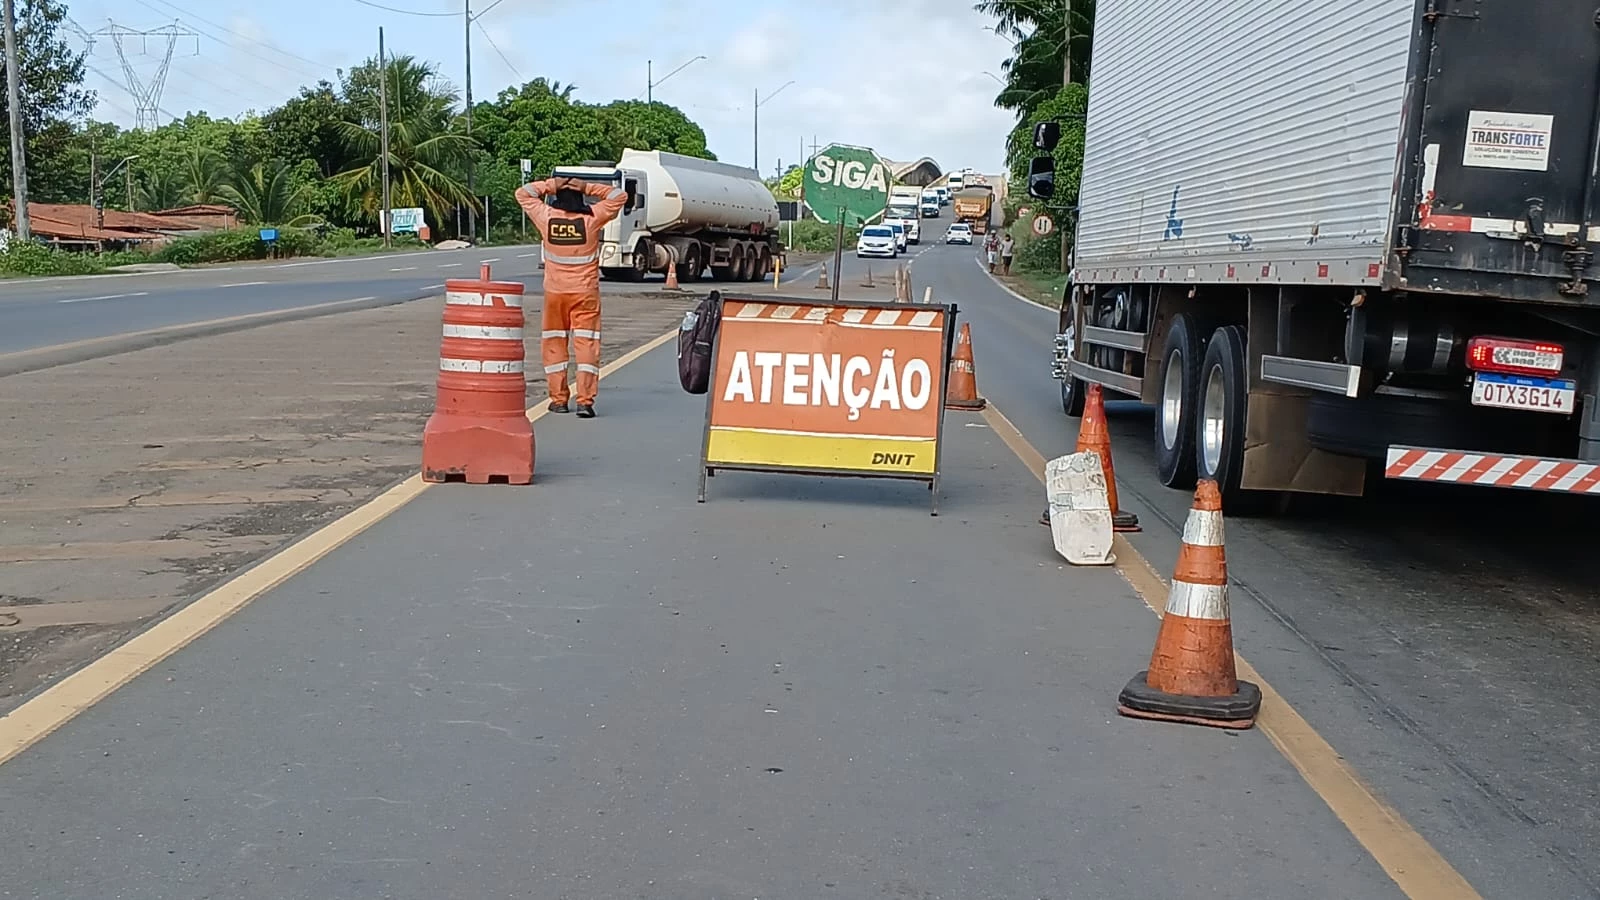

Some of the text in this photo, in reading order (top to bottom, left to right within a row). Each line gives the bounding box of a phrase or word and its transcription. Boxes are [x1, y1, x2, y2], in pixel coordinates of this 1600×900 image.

[1472, 131, 1545, 147] TRANSFORTE
[811, 155, 887, 193] SIGA
[723, 348, 932, 421] ATENÇÃO
[1484, 384, 1562, 408] OTX3G14
[871, 453, 915, 466] DNIT
